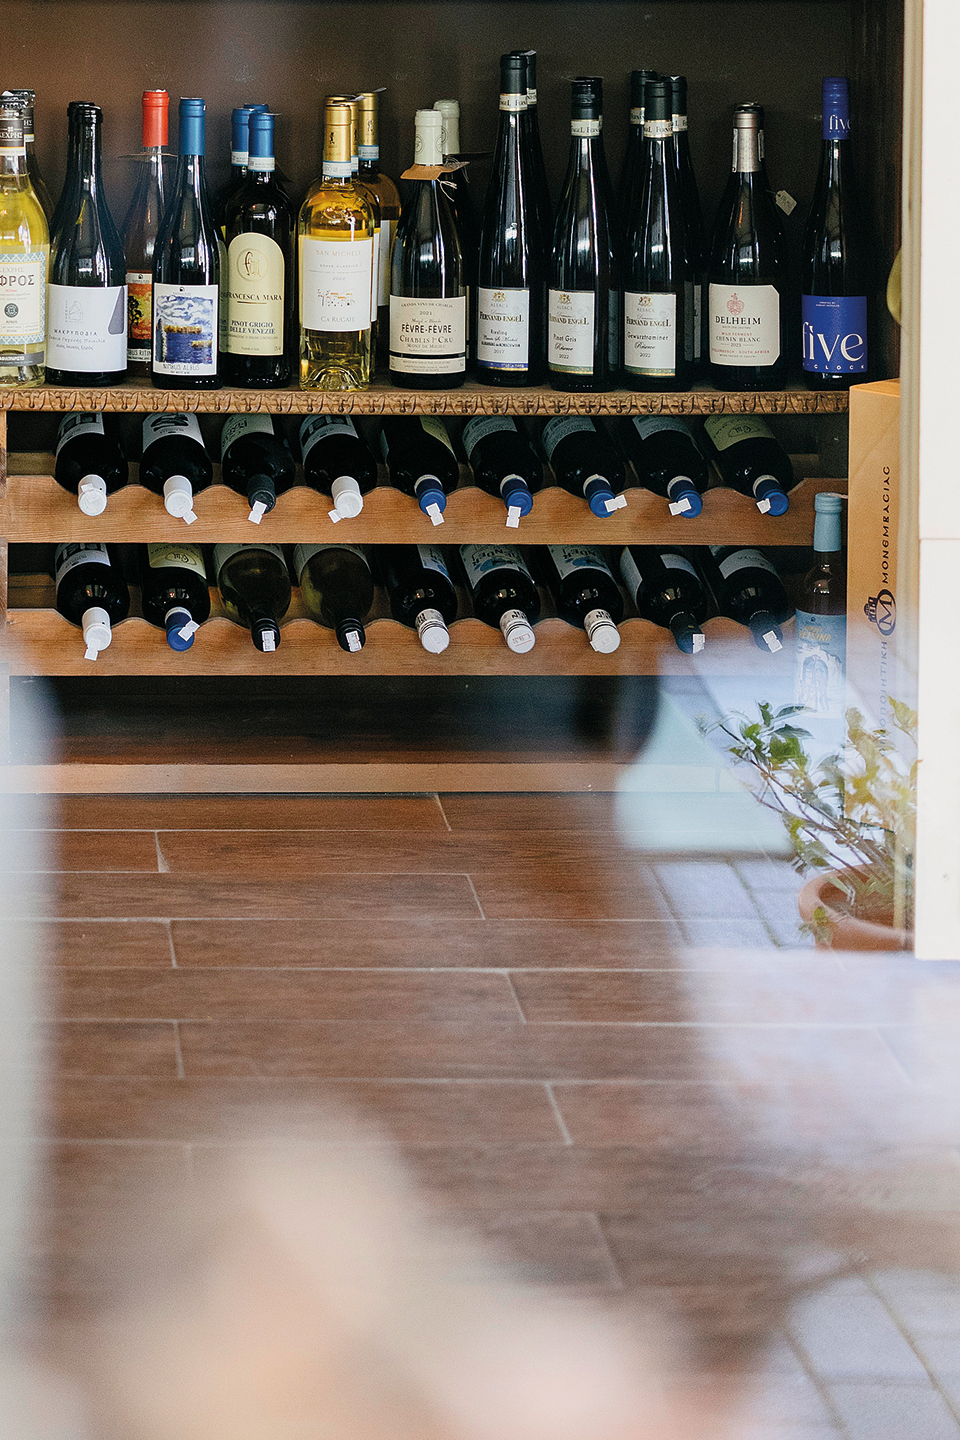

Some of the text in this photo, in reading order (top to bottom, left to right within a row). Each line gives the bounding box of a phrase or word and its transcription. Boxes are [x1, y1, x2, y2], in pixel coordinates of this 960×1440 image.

[626, 316, 671, 327] FERNAND ENGEL
[715, 316, 761, 325] DELHEIM
[802, 321, 864, 362] five
